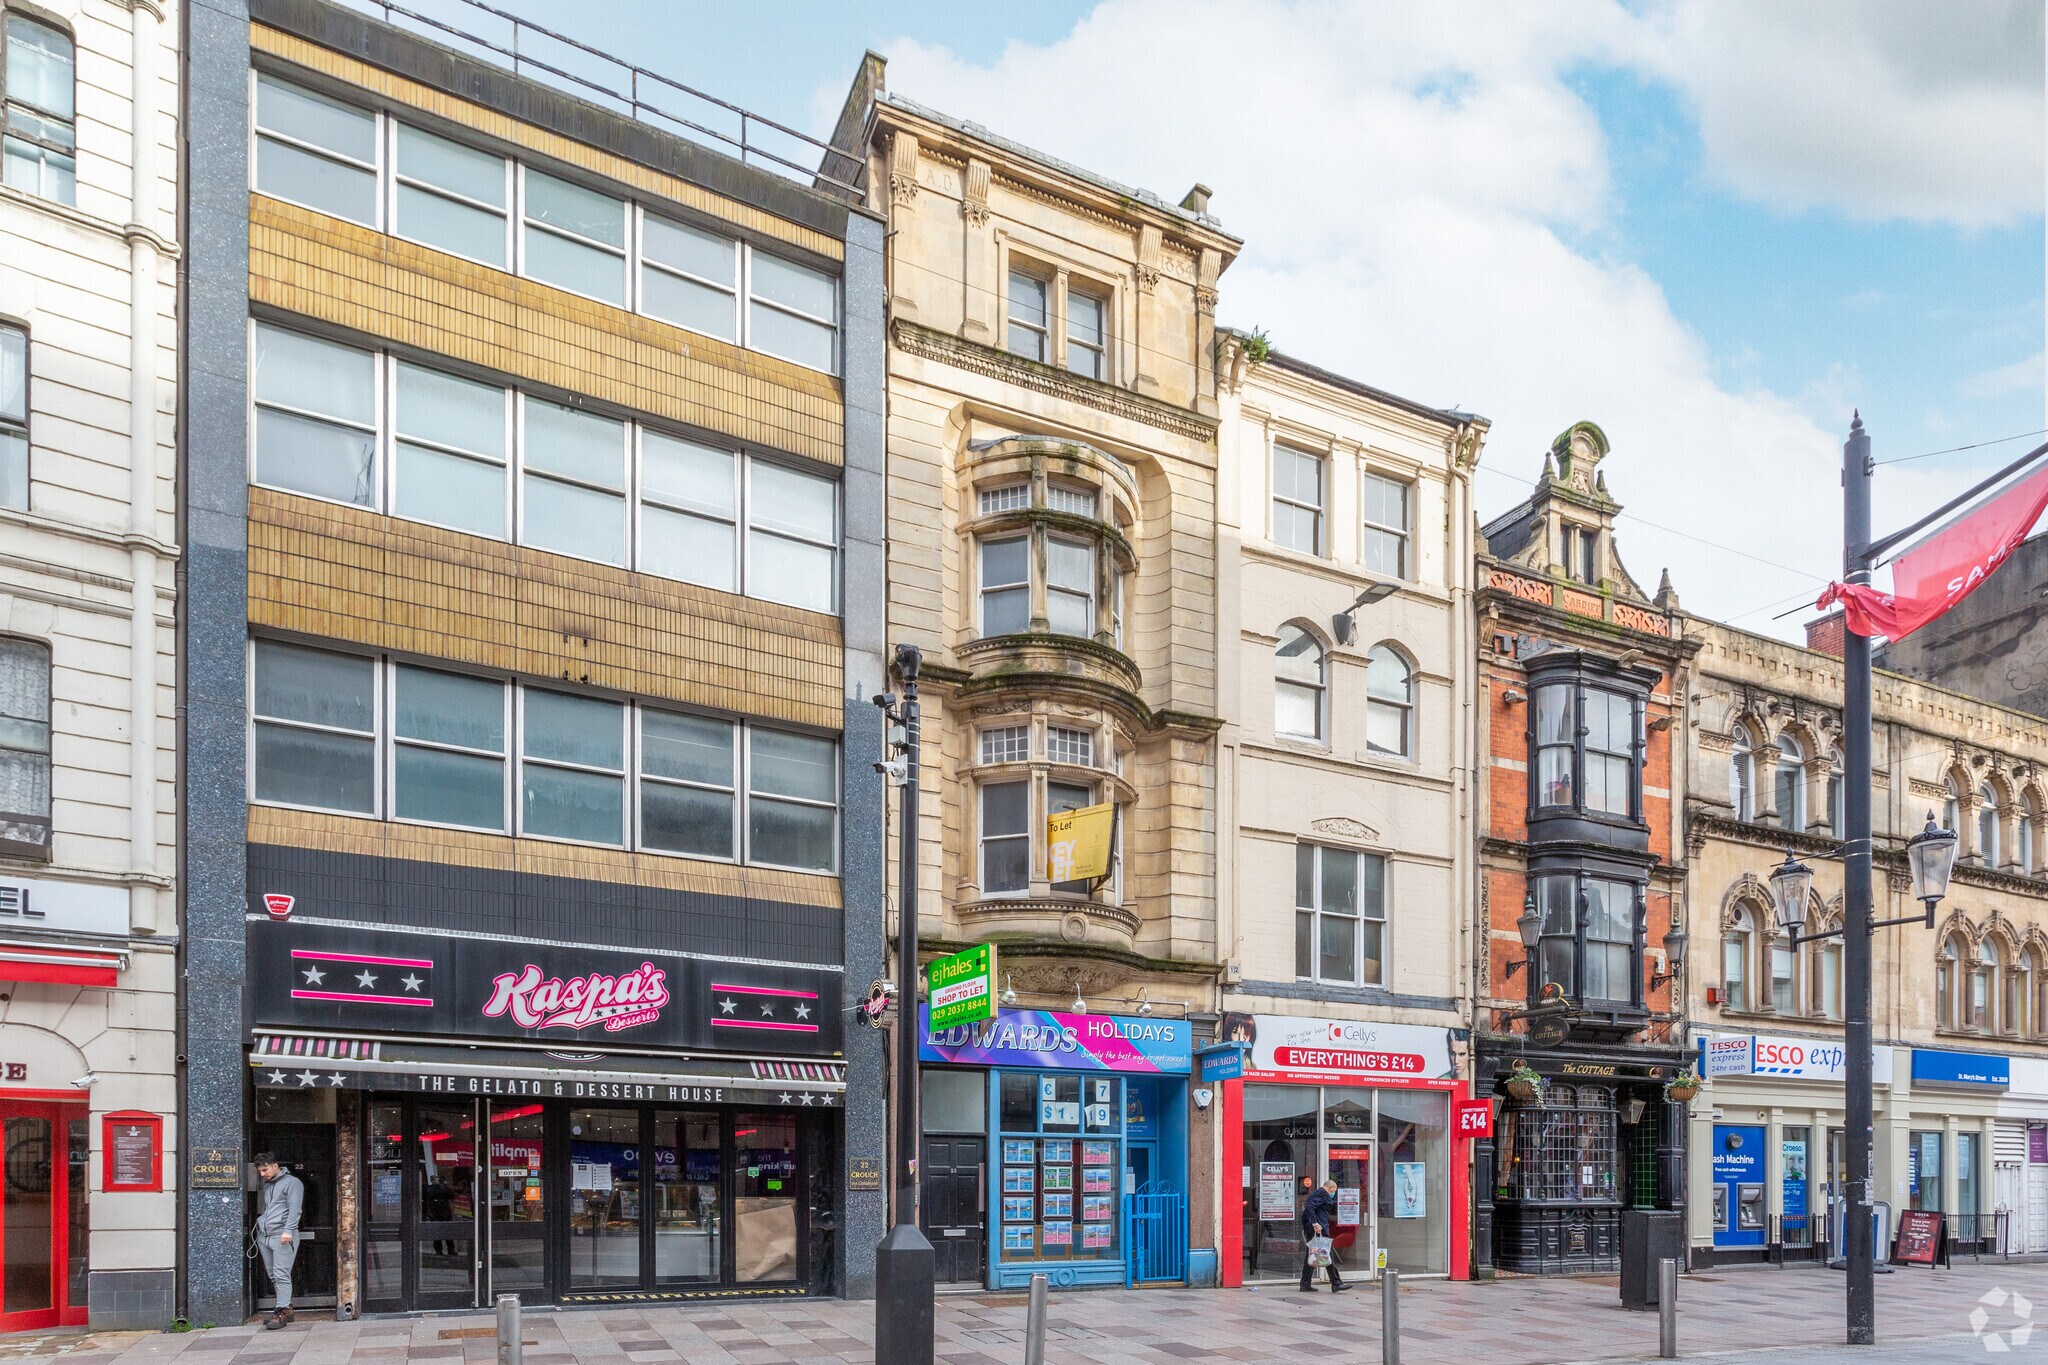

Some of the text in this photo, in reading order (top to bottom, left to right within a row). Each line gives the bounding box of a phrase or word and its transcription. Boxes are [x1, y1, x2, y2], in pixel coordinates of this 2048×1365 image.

[1049, 821, 1072, 832] To Let
[932, 958, 972, 985] ejhales
[938, 985, 983, 1005] SHOP TO LET
[945, 981, 976, 994] GROUND FLOOR
[482, 962, 669, 1030] Kaspa's
[932, 998, 987, 1020] 029 2037 8844
[604, 1008, 659, 1032] Desserts
[937, 1011, 982, 1027] www.ejhales.co.uk
[927, 1021, 1175, 1053] EDWARDS HOLIDAYS
[1344, 1026, 1376, 1045] Celly's
[1710, 1040, 1747, 1050] TESCO
[1080, 1048, 1104, 1063] Simply
[1105, 1050, 1116, 1059] the
[1118, 1051, 1132, 1060] best
[1153, 1056, 1166, 1064] get
[1204, 1055, 1238, 1069] EDWARDS
[1289, 1050, 1415, 1070] EVERYTHING'S £14
[1711, 1053, 1745, 1064] express
[1756, 1044, 1804, 1066] ESCO
[1219, 1067, 1238, 1075] HOLIDAYS
[1563, 1063, 1615, 1076] The COTTAGE
[419, 1075, 723, 1102] THE GELATO & DESSERT HOUSE
[1044, 1083, 1108, 1097] € 7
[1461, 1112, 1486, 1129] £14
[208, 1153, 222, 1161] 22
[1713, 1155, 1754, 1164] ash Machine
[193, 1165, 236, 1173] CROUCH
